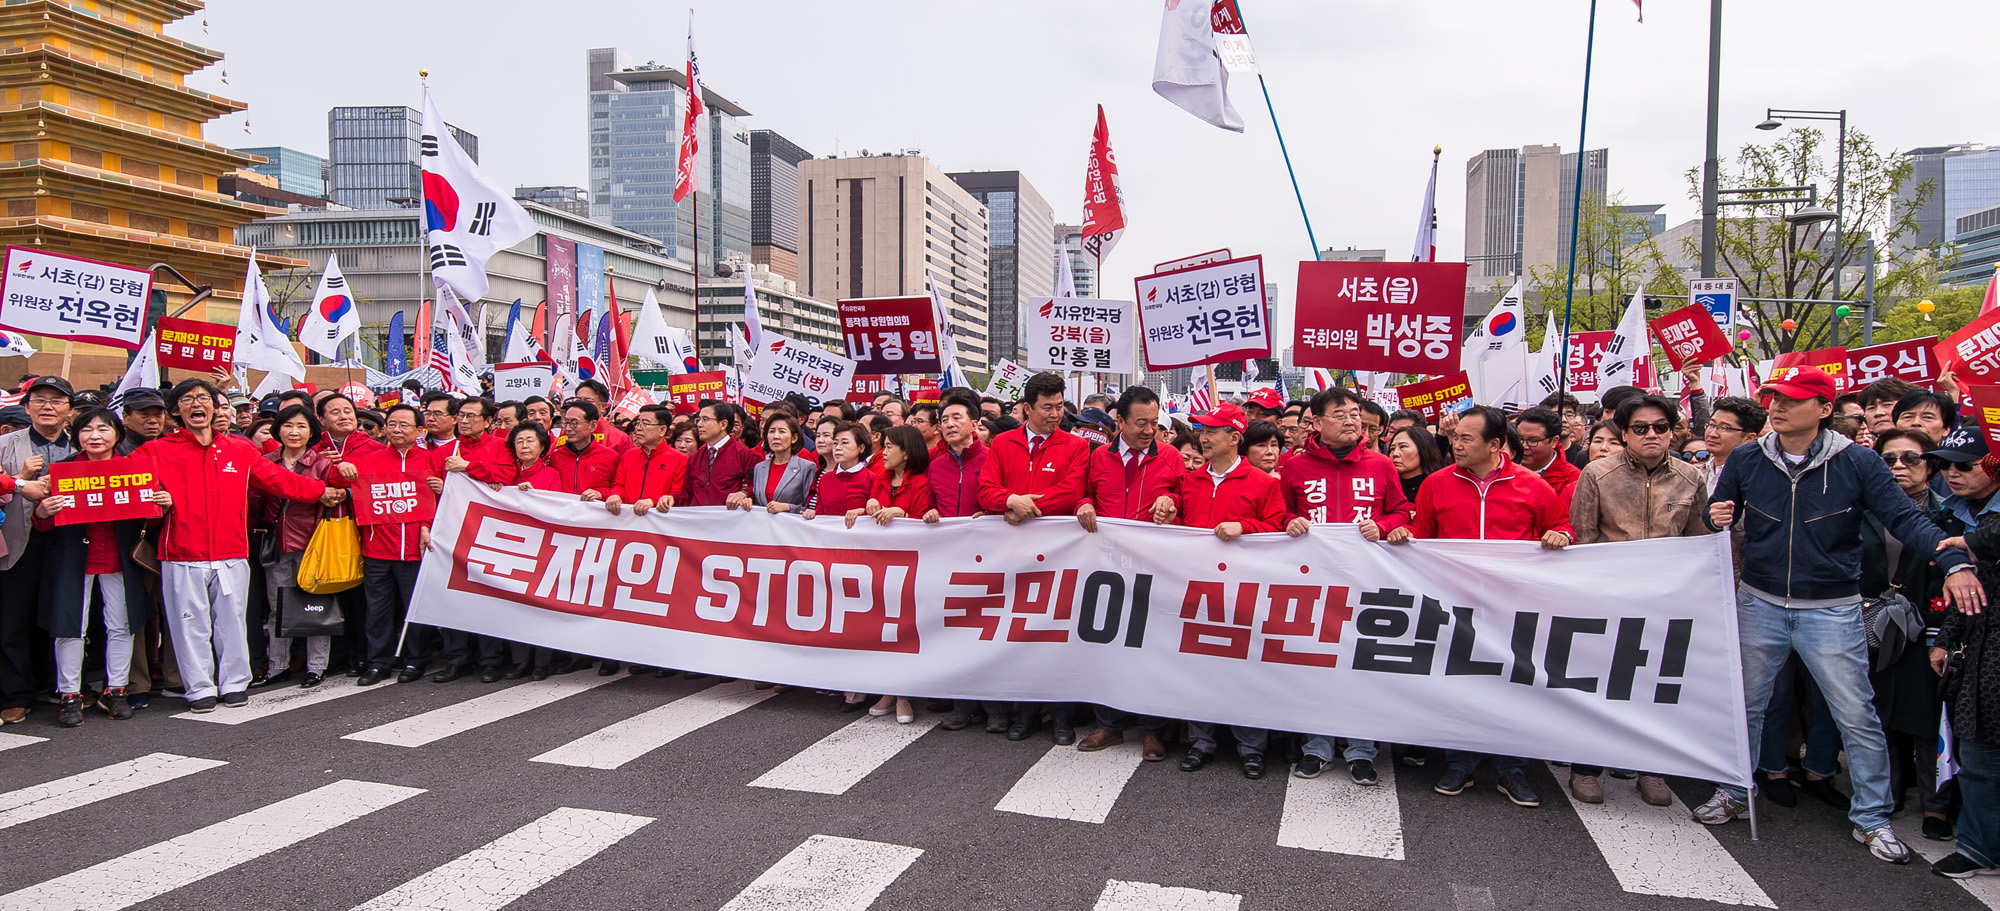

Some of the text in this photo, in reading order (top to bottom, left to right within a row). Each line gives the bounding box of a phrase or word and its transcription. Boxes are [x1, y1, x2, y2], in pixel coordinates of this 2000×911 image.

[40, 266, 143, 298] 서초(갑) 당협
[1165, 273, 1256, 305] 서초(갑) 당협
[1337, 277, 1418, 304] 서초(을)
[1693, 282, 1734, 290] 세종대로
[8, 293, 140, 332] 위원장 전옥현
[870, 315, 910, 326] 당원협의회
[1054, 305, 1122, 324] 자유한국당
[1050, 325, 1111, 345] 강북(을)
[1149, 304, 1261, 345] 위원장 전옥현
[1661, 318, 1699, 344] 문재인
[161, 329, 233, 348] 문재인 STOP
[1302, 313, 1453, 360] 국회의원 박성중
[783, 346, 844, 378] 자유한국당
[1048, 346, 1111, 369] 안홍렬
[1969, 347, 2000, 376] ST
[505, 377, 542, 388] 고양시 을
[672, 383, 697, 394] 문재인
[698, 381, 723, 391] STOP
[773, 363, 829, 395] 강남(병)
[848, 380, 879, 393] 성시
[749, 380, 785, 401] 국회의원
[1402, 393, 1433, 408] 문재인
[1434, 383, 1466, 401] STOP
[58, 473, 153, 492] 문재인 STOP
[370, 481, 417, 499] 문재인
[373, 498, 418, 515] STOP
[304, 604, 324, 613] Jeep
[467, 516, 1694, 704] 문재인 STOP! 국민이 심판합니다!
